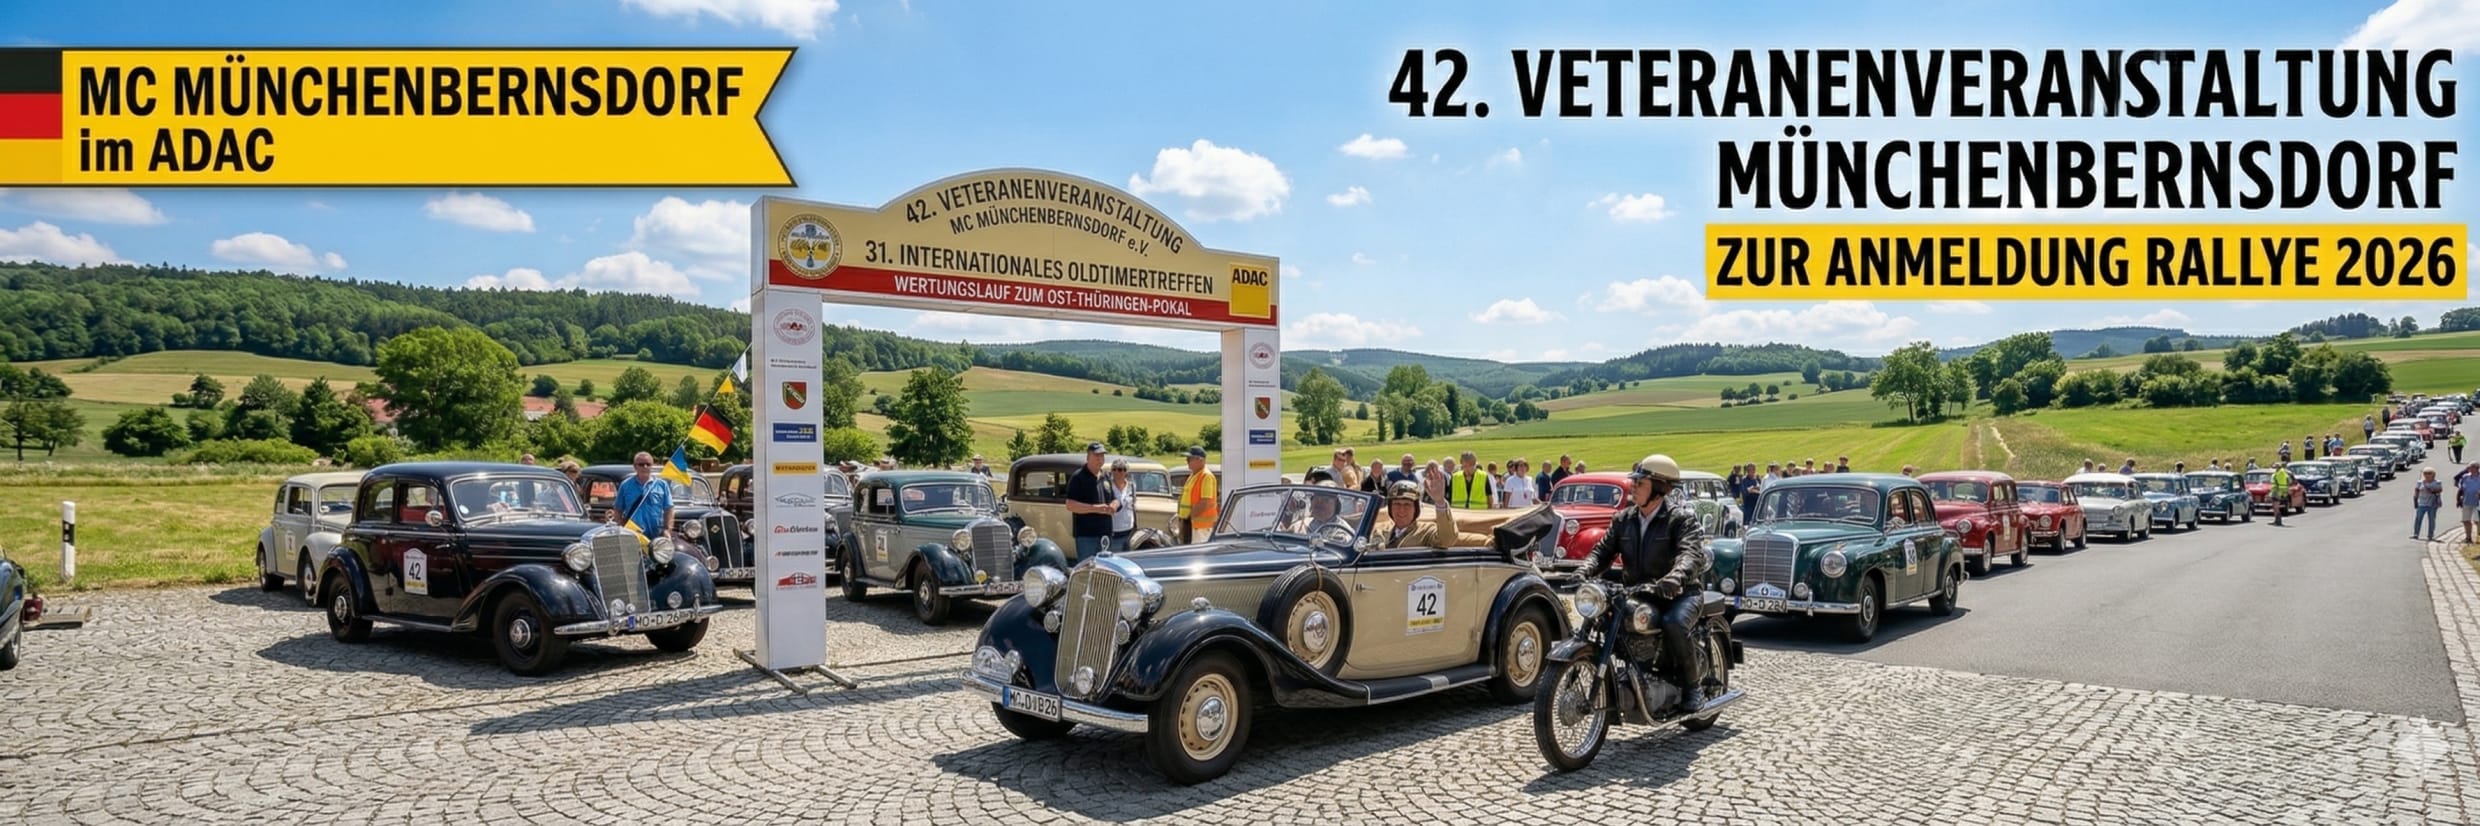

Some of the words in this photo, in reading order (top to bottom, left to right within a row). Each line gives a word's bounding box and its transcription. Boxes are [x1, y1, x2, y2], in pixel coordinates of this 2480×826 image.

[906, 199, 937, 224] 42.
[937, 178, 1184, 254] VETERANENVERANSTALTUNG
[949, 214, 974, 235] MC
[976, 205, 1127, 244] MÜNCHENBERNSDORF
[1127, 237, 1150, 257] e.V.
[865, 239, 894, 265] 31.
[899, 243, 1064, 281] INTERNATIONALES
[1067, 261, 1214, 295] OLDTIMERTREFFEN
[1232, 267, 1269, 287] ADAC
[894, 274, 1012, 301] WERTUNGSLAUF
[1014, 285, 1045, 304] ZUM
[1047, 289, 1193, 317] OST-THÜRINGEN-POKAL
[408, 561, 422, 581] 42
[1415, 592, 1438, 617] 42
